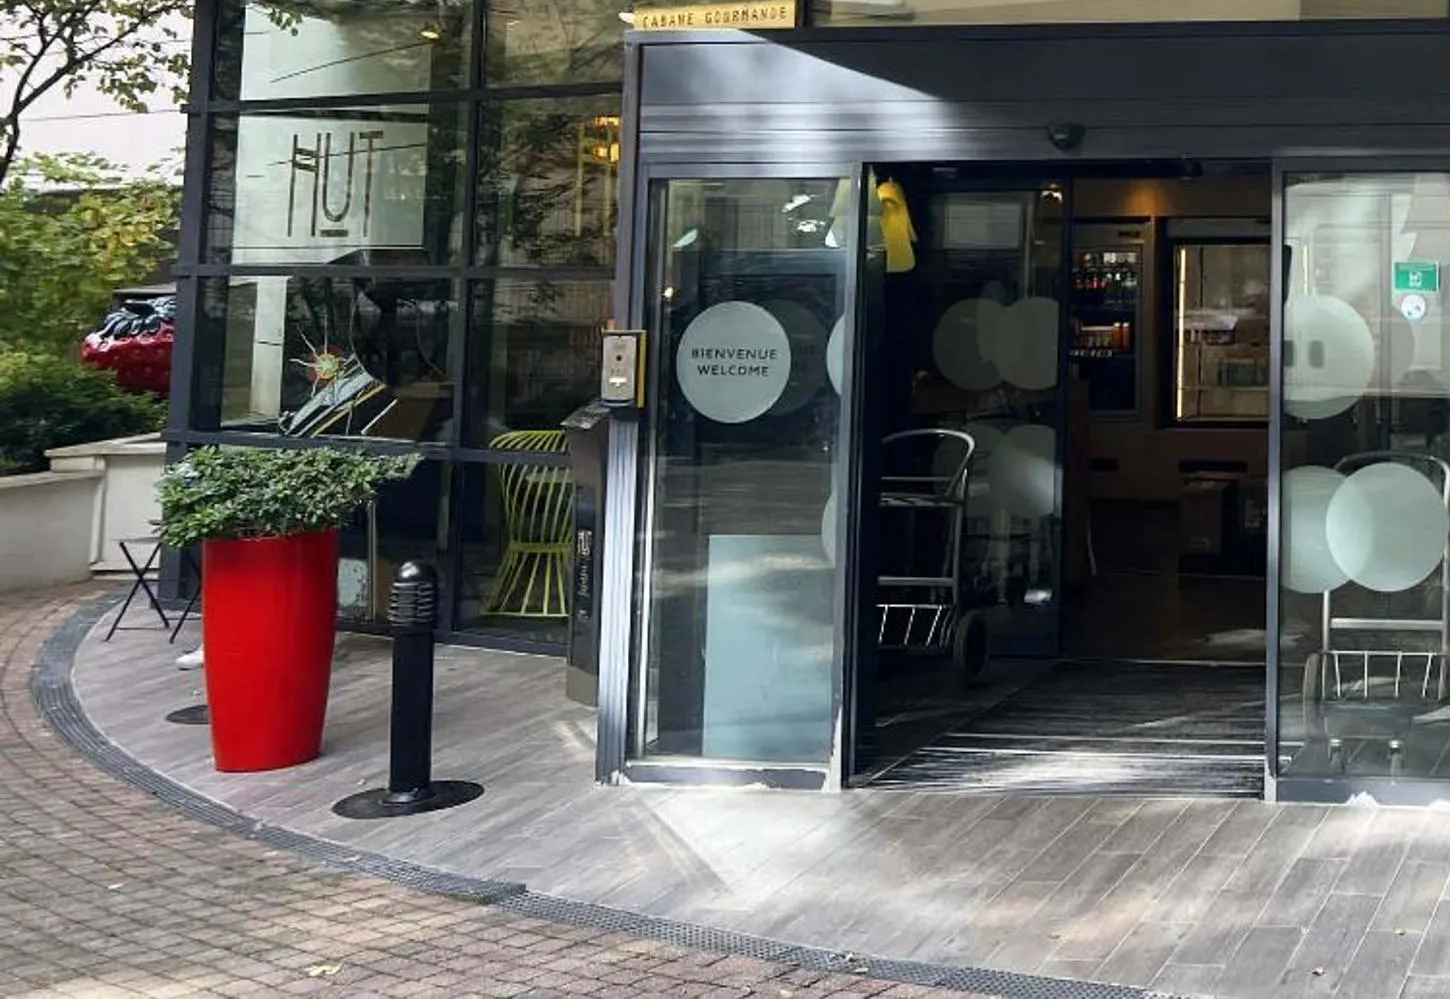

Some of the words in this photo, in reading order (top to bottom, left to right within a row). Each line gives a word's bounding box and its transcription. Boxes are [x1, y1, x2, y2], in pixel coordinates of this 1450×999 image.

[705, 6, 788, 24] GOURMANDE
[288, 130, 384, 237] HUT
[691, 348, 778, 360] BIENVENUE
[697, 364, 769, 376] WELCOME
